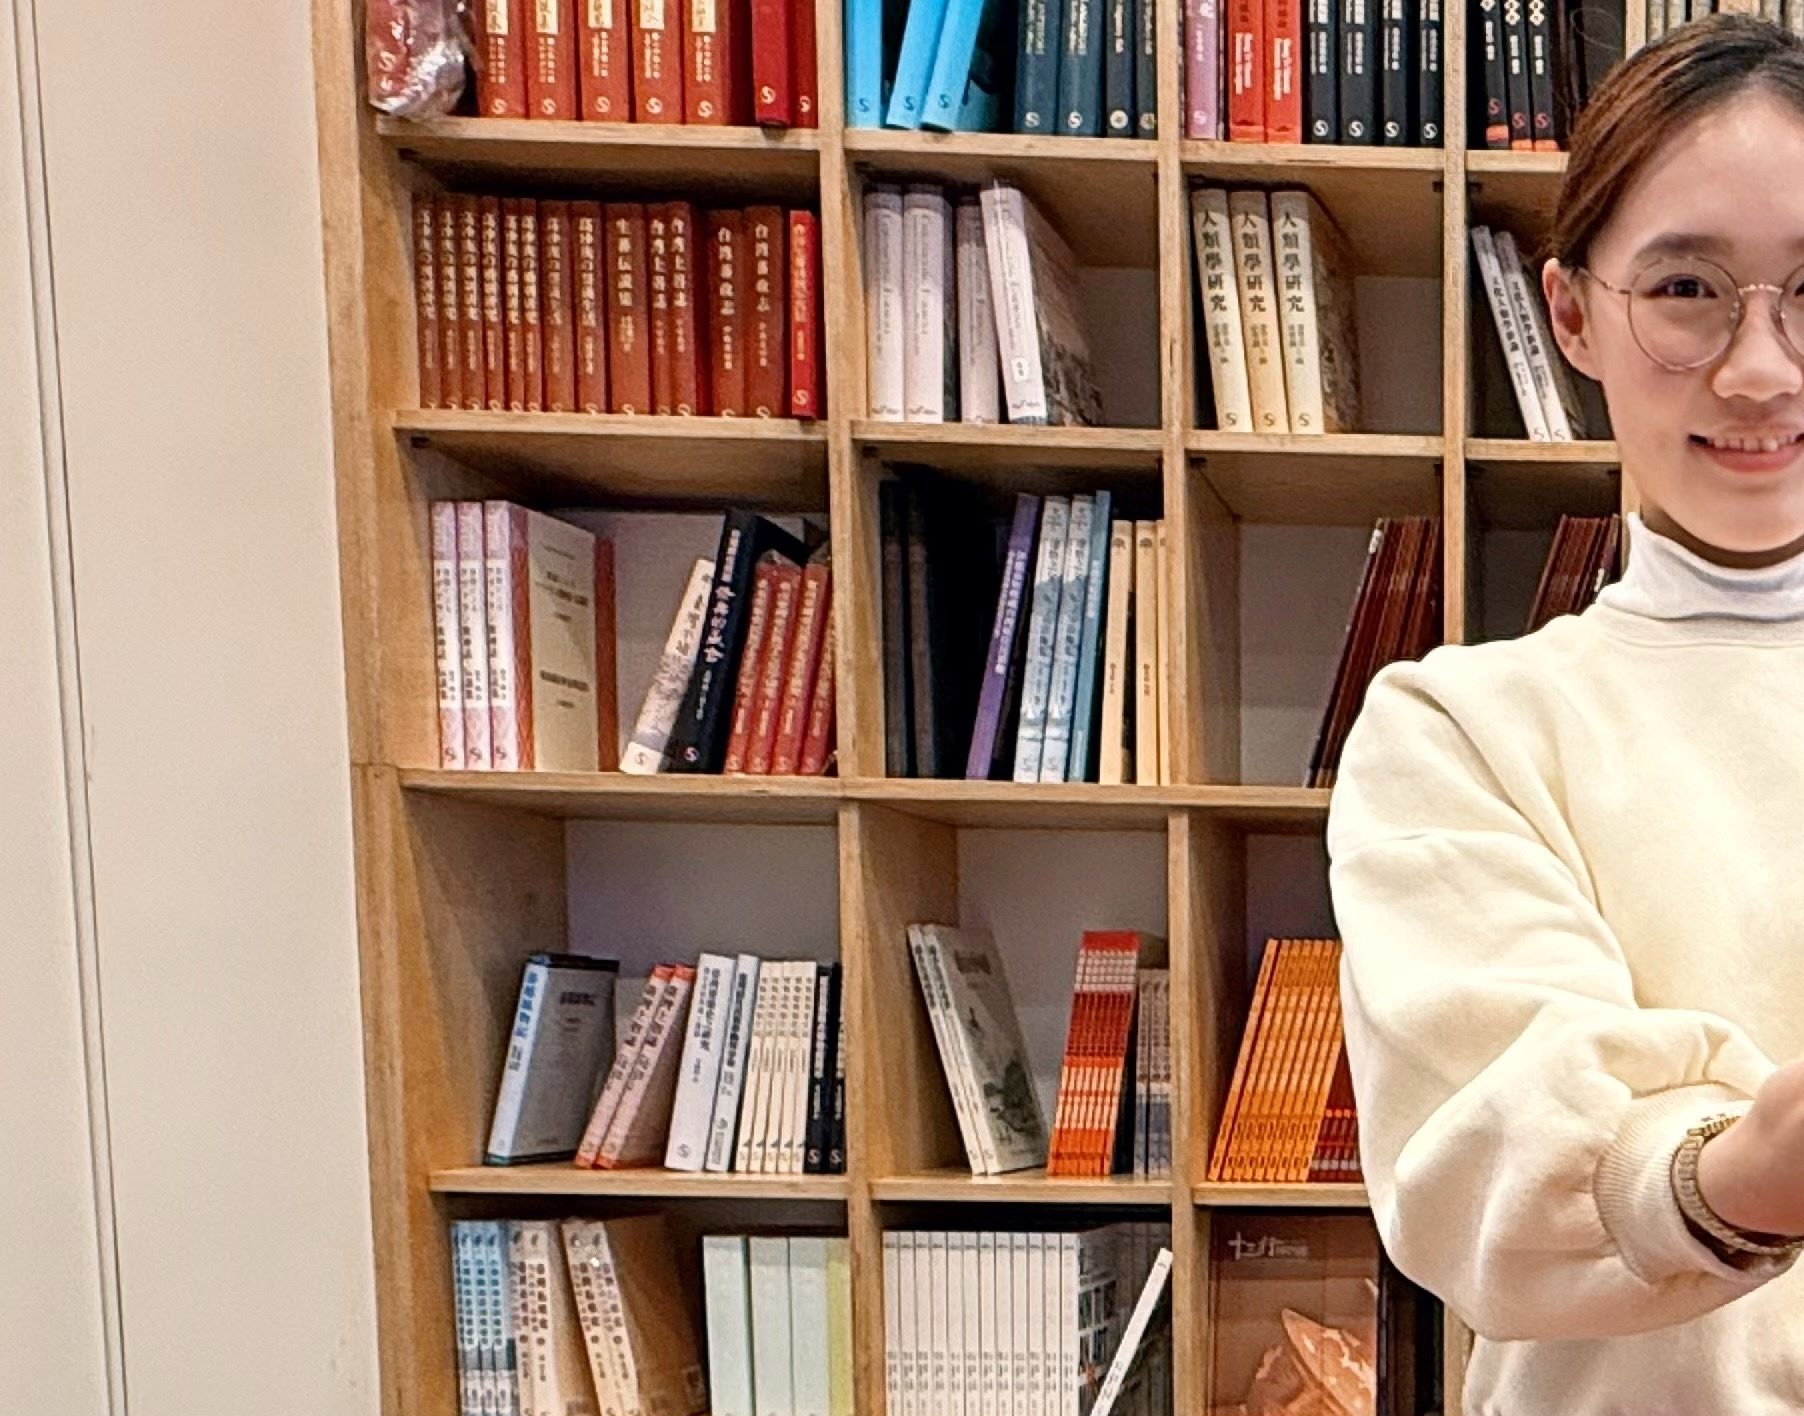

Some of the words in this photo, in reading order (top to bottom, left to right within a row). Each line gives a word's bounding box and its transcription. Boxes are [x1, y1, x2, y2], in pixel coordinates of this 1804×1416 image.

[1201, 209, 1228, 313] 人類學研究
[1241, 210, 1267, 313] 人類學研究
[1281, 210, 1305, 313] 人類學研究
